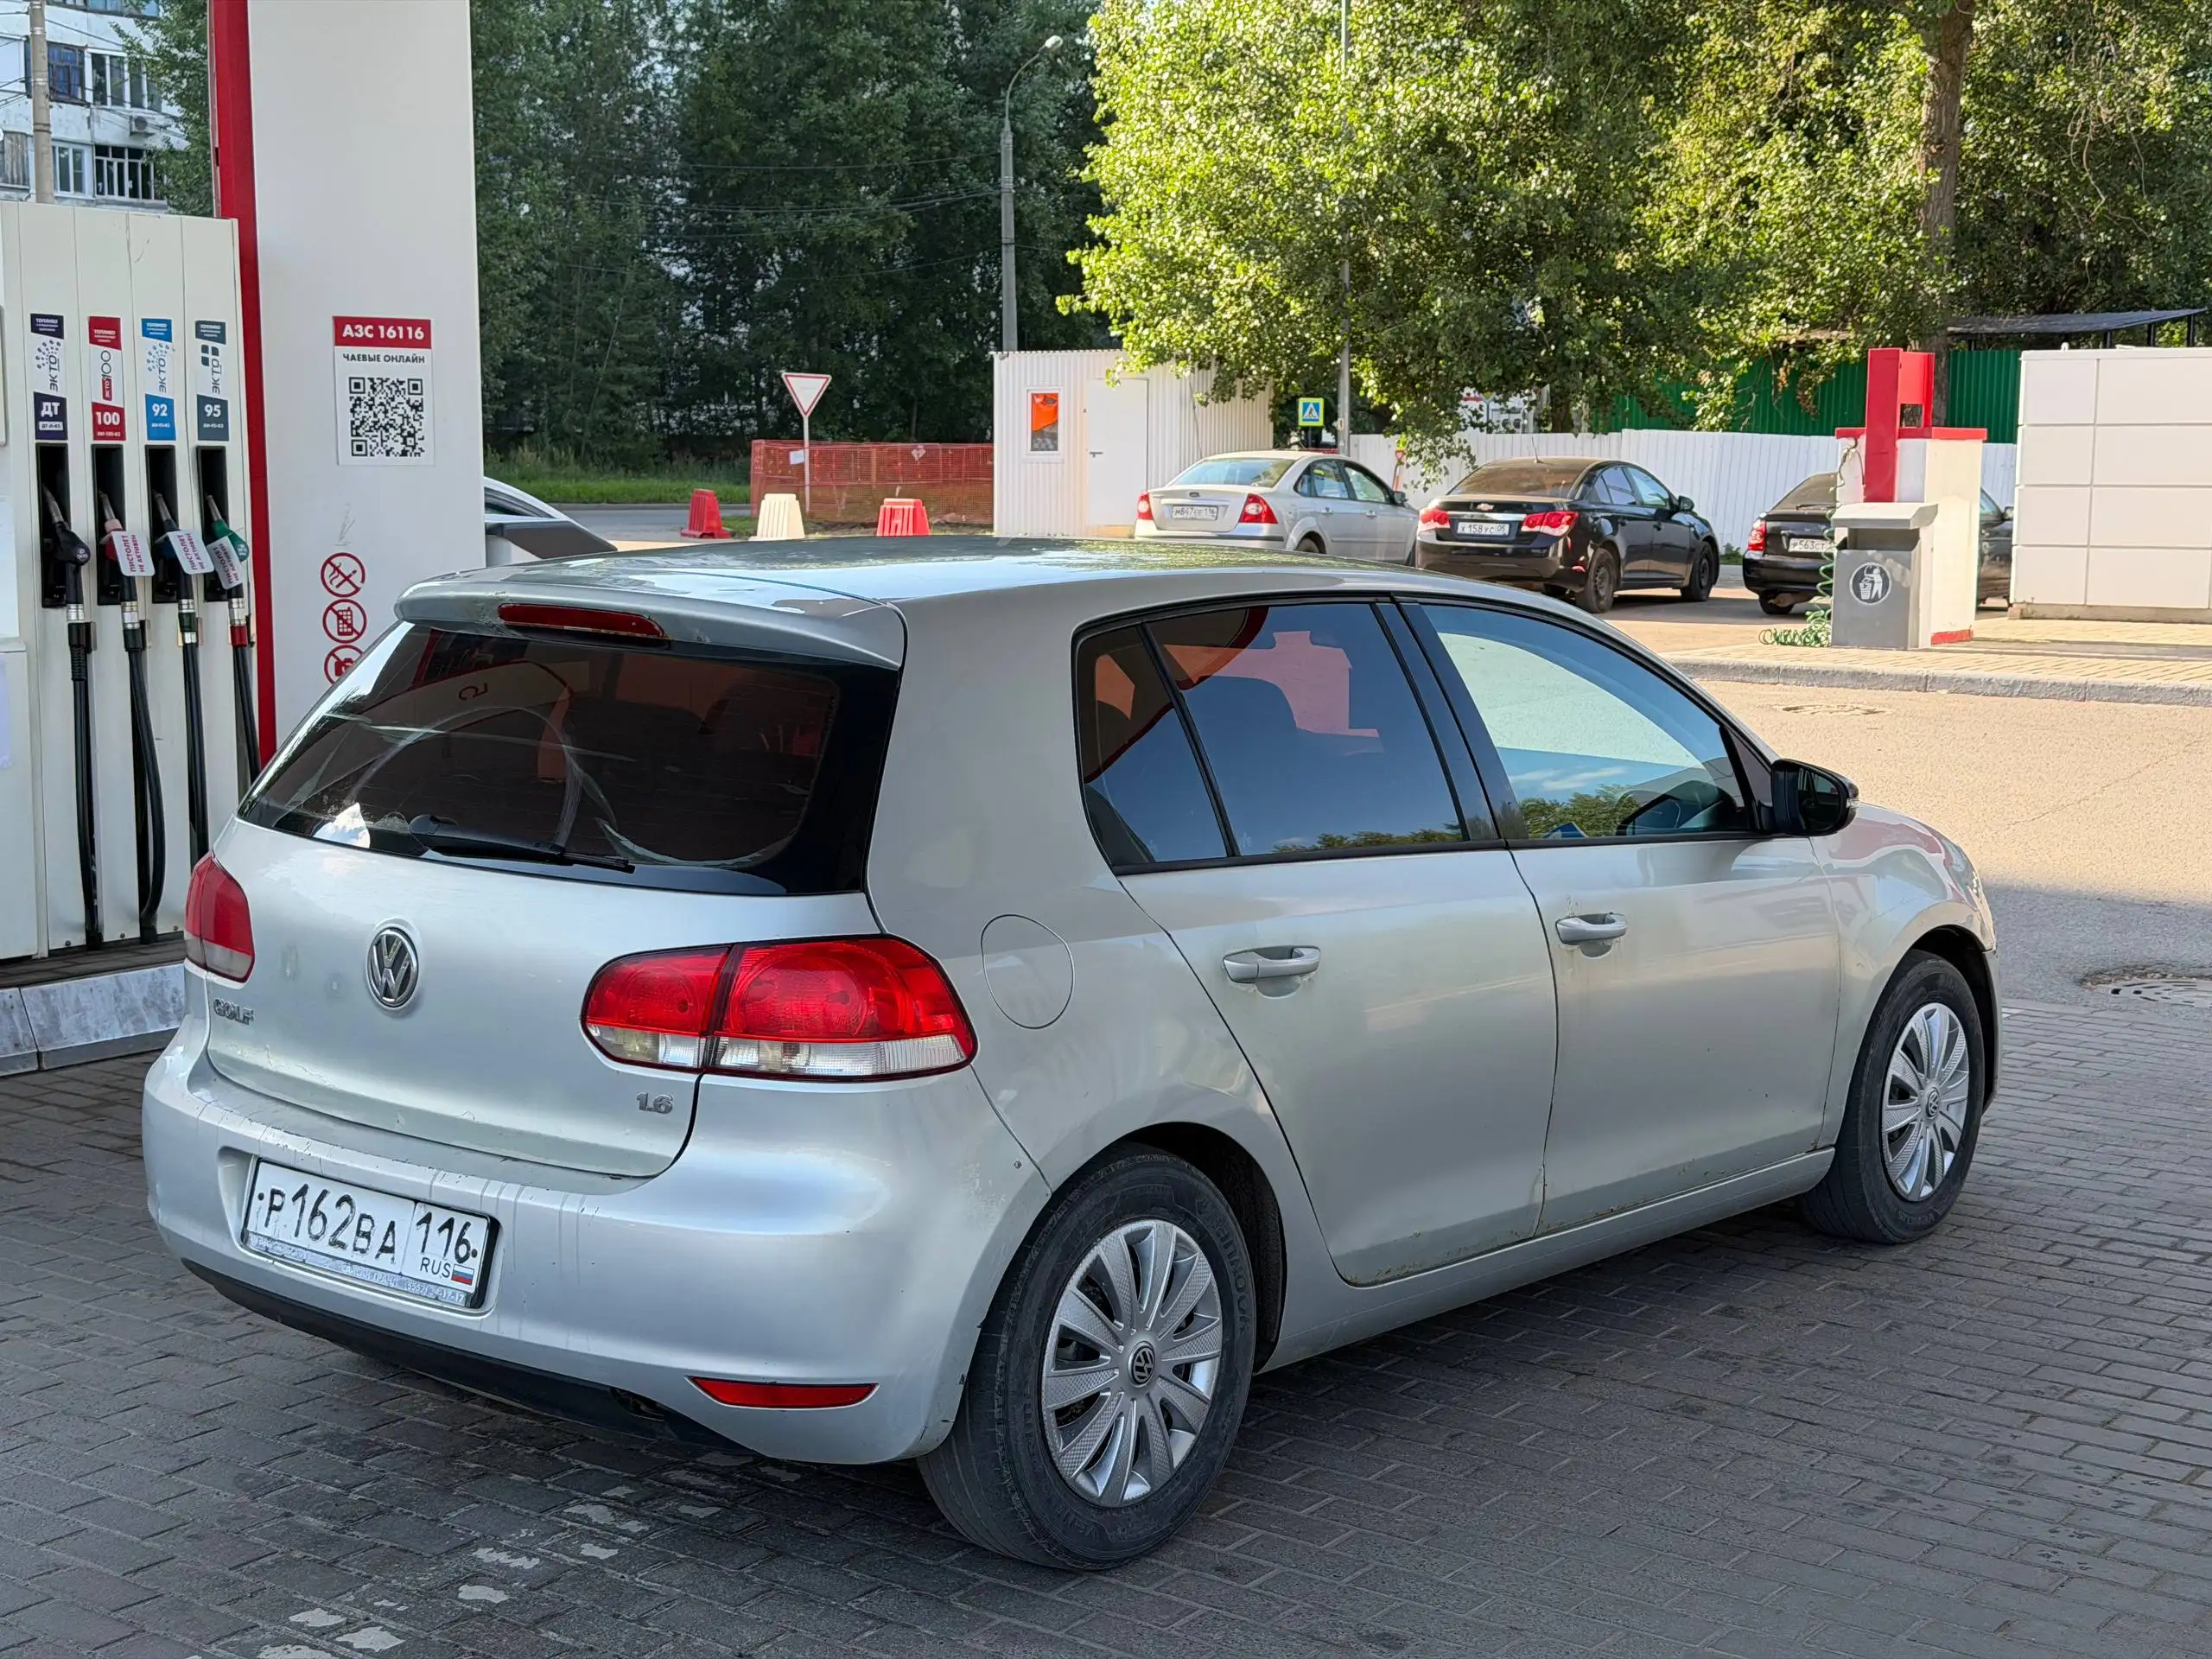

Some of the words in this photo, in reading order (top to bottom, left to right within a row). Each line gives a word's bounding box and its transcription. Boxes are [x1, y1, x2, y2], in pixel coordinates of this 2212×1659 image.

[342, 324, 374, 339] АЗС
[378, 325, 424, 340] 16116
[342, 353, 382, 363] ЧАЕВЫЕ
[384, 353, 425, 364] ОНЛАЙН
[48, 354, 60, 392] ЭКТО
[158, 358, 168, 394] ЭКТО
[211, 359, 222, 395] ЭКТО
[41, 402, 60, 418] ДТ
[95, 411, 121, 426] 100
[152, 404, 168, 416] 92
[204, 404, 222, 418] 95
[213, 999, 254, 1026] GOLF
[264, 1183, 396, 1264] Р162ВА
[416, 1211, 473, 1264] 116
[420, 1256, 451, 1279] RUS
